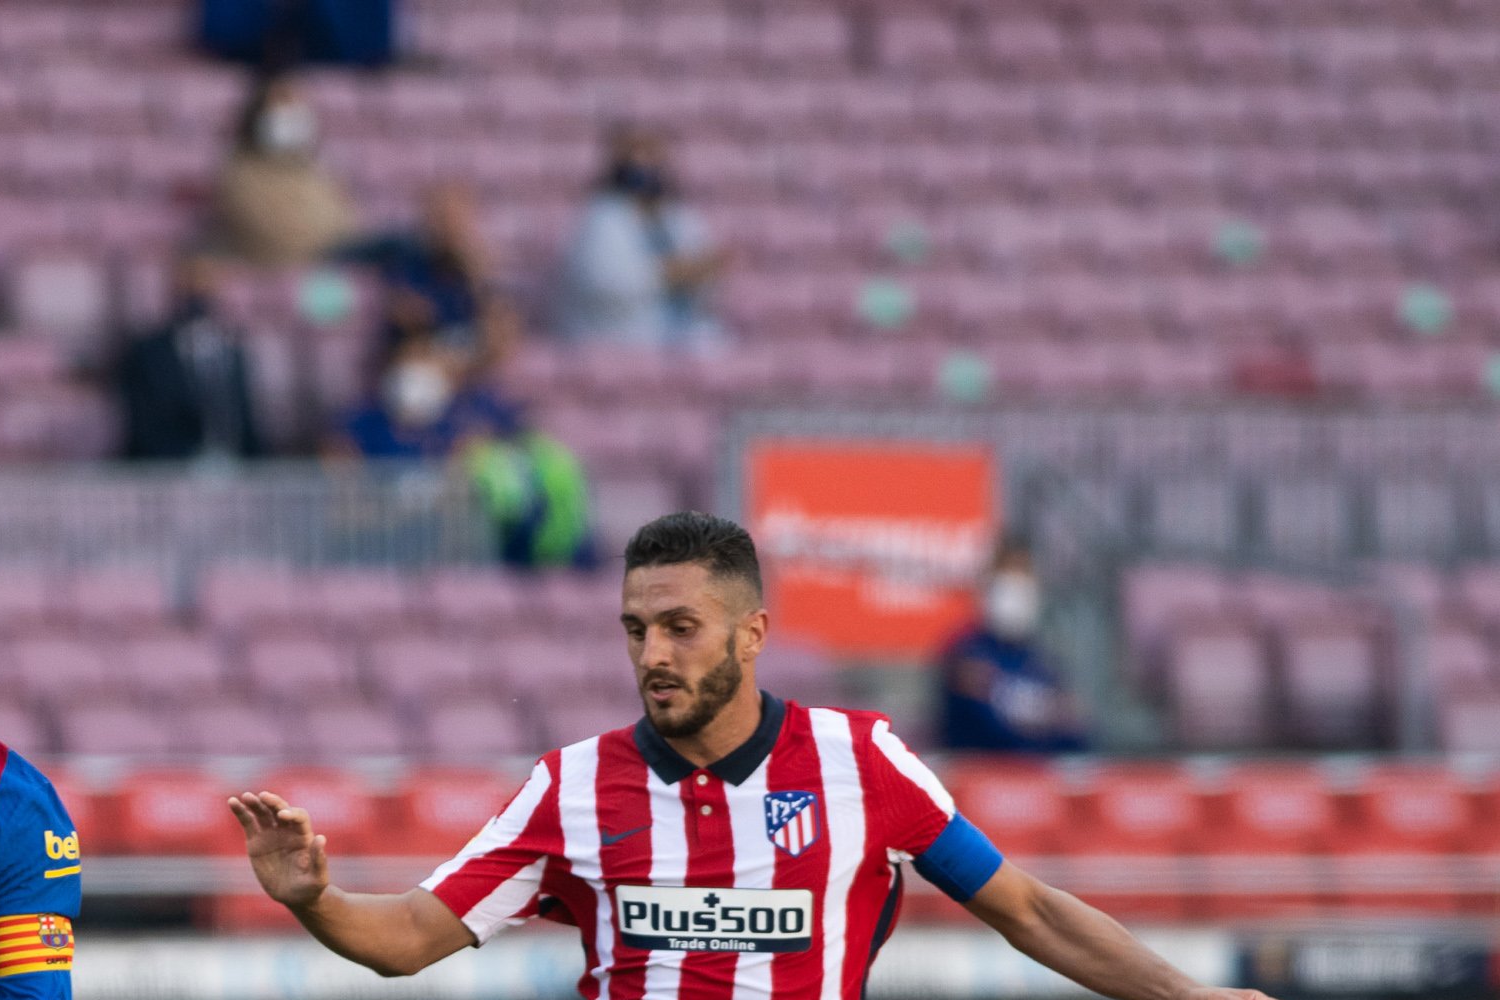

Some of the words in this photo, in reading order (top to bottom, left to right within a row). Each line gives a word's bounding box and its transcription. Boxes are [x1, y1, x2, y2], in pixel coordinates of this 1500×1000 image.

[622, 901, 804, 934] Plus500
[668, 938, 706, 950] Trade
[710, 939, 756, 951] Online
